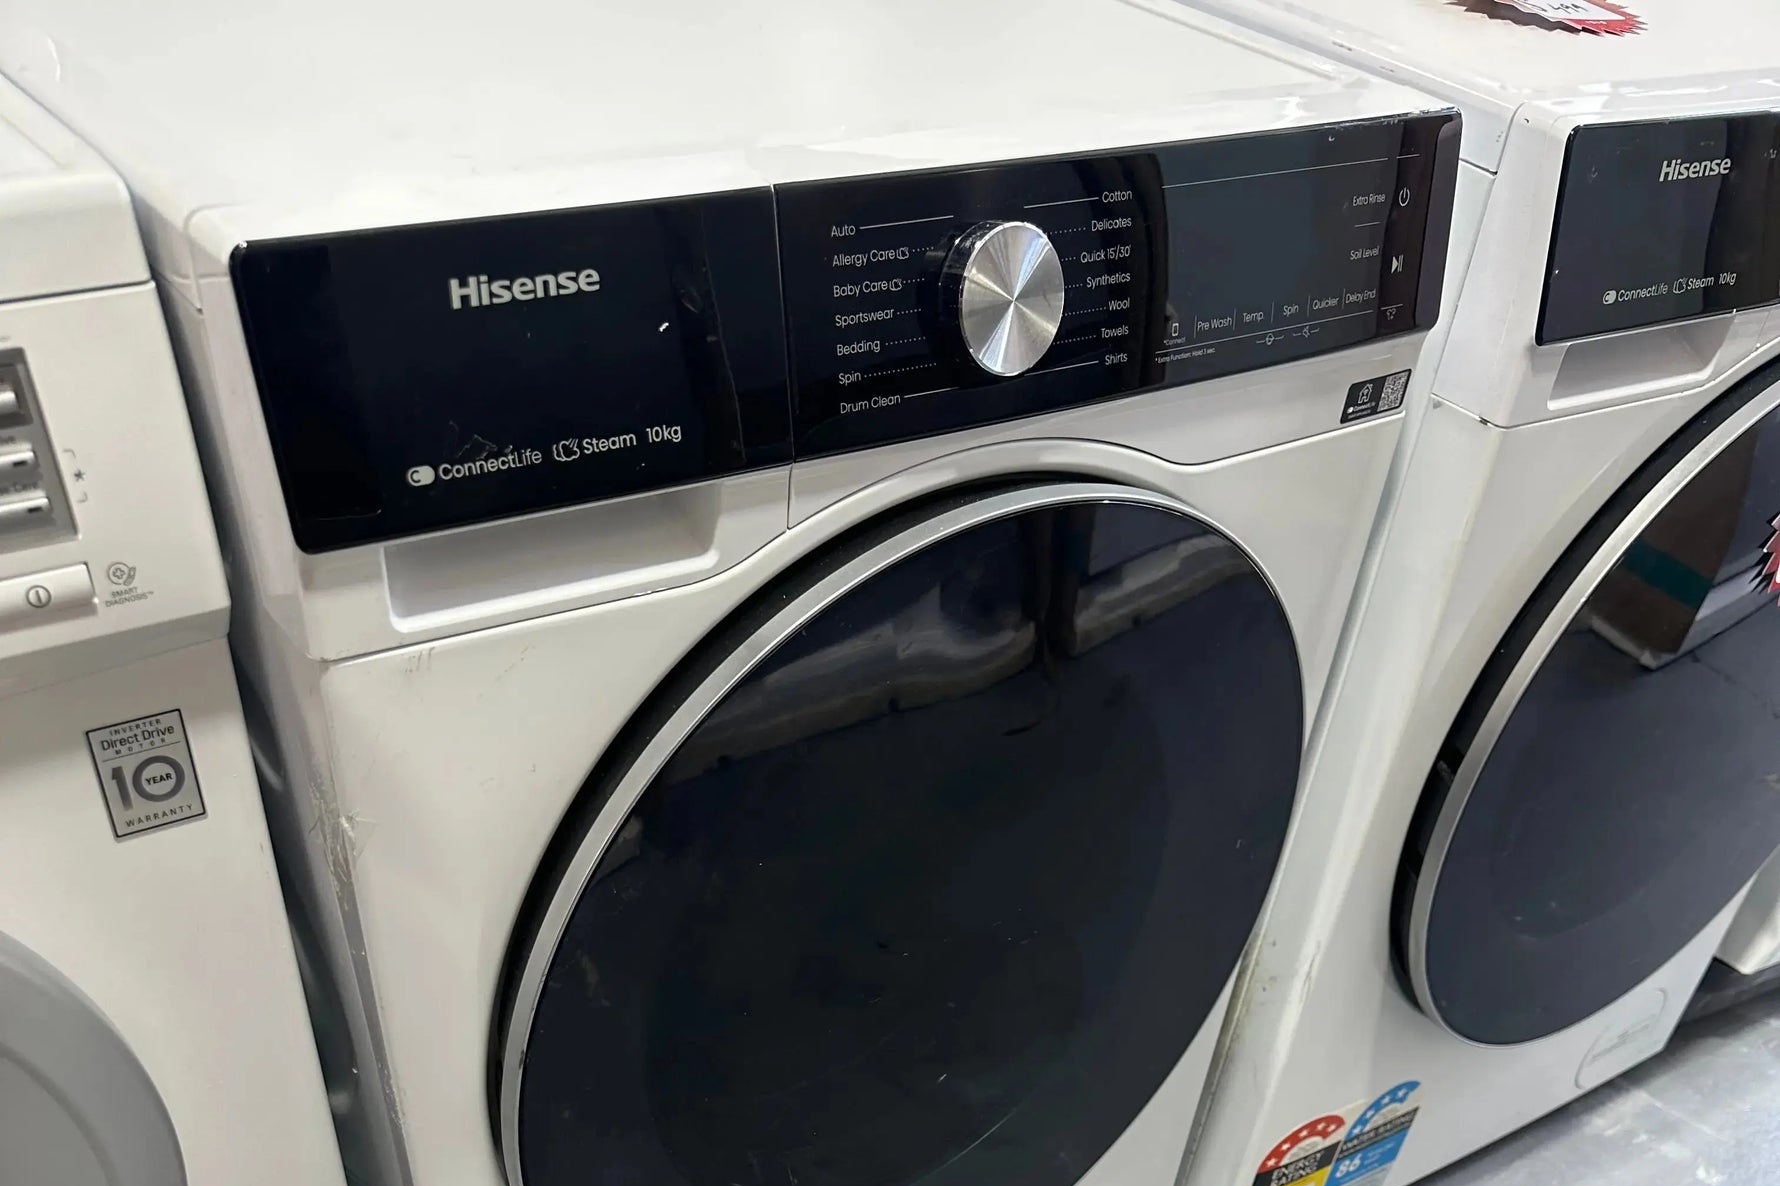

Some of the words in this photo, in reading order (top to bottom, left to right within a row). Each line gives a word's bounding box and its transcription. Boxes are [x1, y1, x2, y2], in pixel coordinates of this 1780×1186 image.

[1659, 157, 1732, 182] Hisense
[1102, 189, 1133, 204] Cotton
[1352, 195, 1369, 207] Extra
[1369, 193, 1386, 204] Rinse
[830, 224, 856, 238] Auto
[1091, 216, 1132, 232] Delicates
[832, 251, 868, 267] Allergy
[870, 249, 896, 262] Care
[1080, 250, 1106, 265] Quick
[1350, 248, 1362, 261] Soil
[1362, 245, 1380, 258] Level
[1086, 272, 1131, 289] Synthetics
[1617, 282, 1669, 302] ConnectLife
[1687, 275, 1715, 290] Steam
[1718, 271, 1737, 286] 10kg
[449, 268, 601, 310] Hisense
[833, 283, 861, 299] Baby
[862, 280, 889, 294] Care
[1345, 291, 1364, 304] Delay
[1364, 288, 1377, 300] End
[1108, 298, 1131, 311] Wool
[1283, 303, 1299, 317] Spin
[1312, 296, 1340, 310] Quicker
[835, 308, 894, 328] Sportswear
[1197, 321, 1210, 332] Pre
[1211, 316, 1233, 329] Wash
[1100, 324, 1129, 339] Towels
[836, 338, 881, 357] Bedding
[1104, 352, 1128, 366] Shirts
[838, 370, 861, 386] Spin
[839, 399, 869, 415] Drum
[871, 394, 901, 409] Clean
[439, 448, 543, 481] ConnectLife
[582, 431, 637, 455] Steam
[645, 424, 682, 444] 10kg
[111, 586, 138, 599] SMART
[109, 718, 162, 737] INVERTER
[100, 732, 141, 752] Direct
[141, 724, 175, 743] Drive
[115, 738, 167, 755] MOTOR
[111, 755, 186, 811] 10
[145, 772, 174, 786] YEAR
[125, 803, 194, 828] WARRANTY
